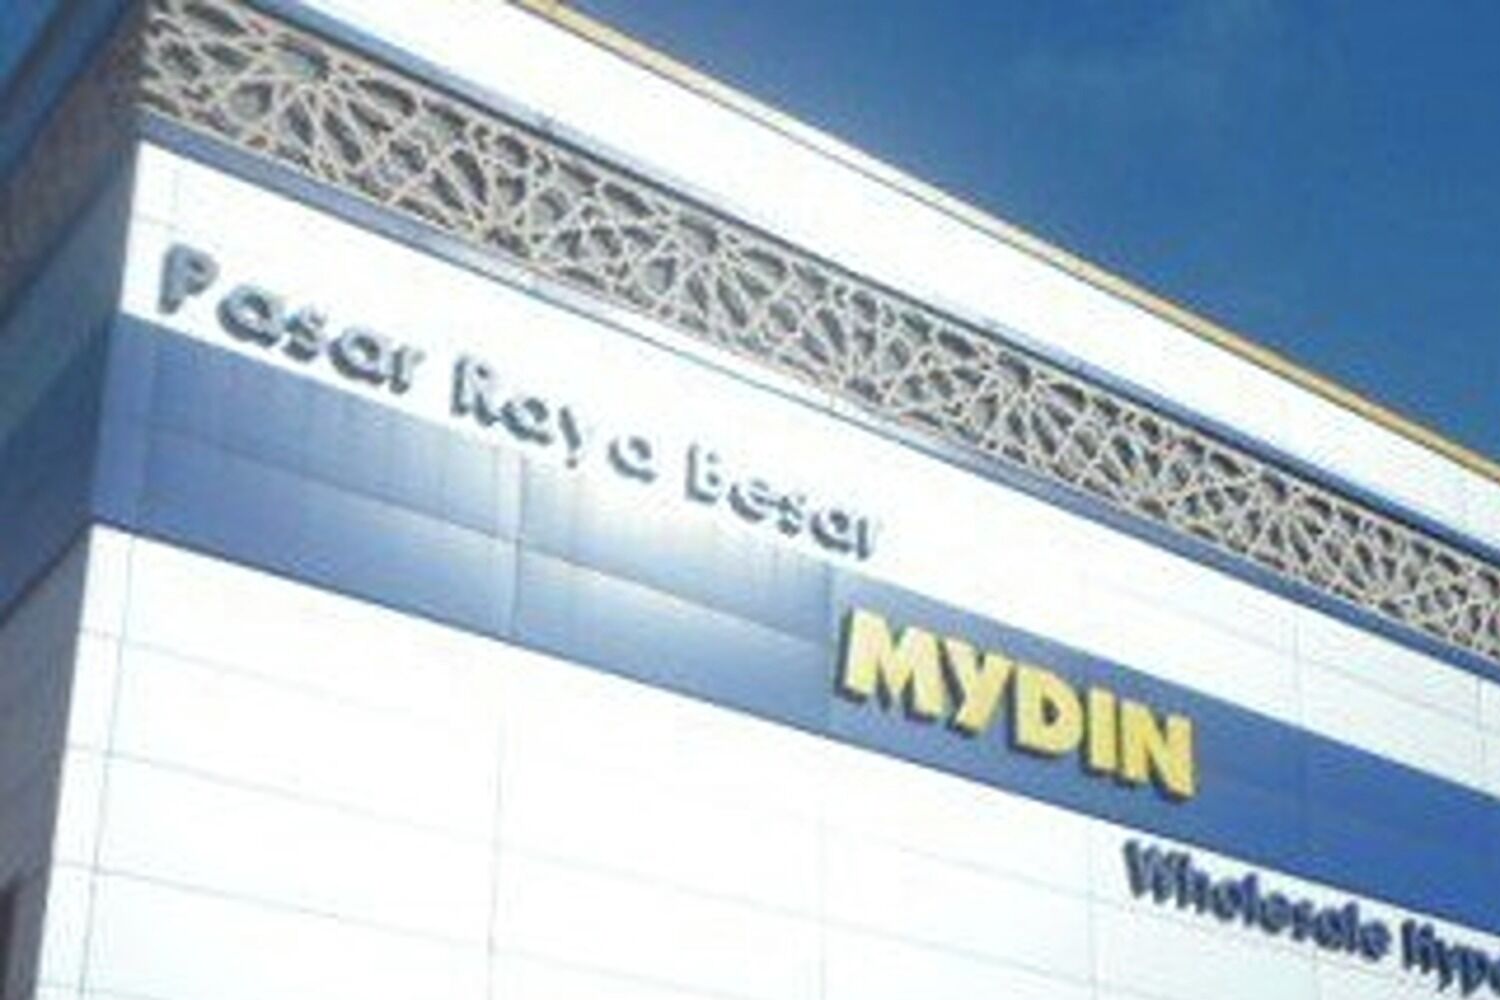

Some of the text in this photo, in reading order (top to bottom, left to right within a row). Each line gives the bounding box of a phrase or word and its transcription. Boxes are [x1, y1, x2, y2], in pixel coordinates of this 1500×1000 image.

[156, 242, 876, 560] Pasar Raya Besar
[838, 607, 1196, 799] MYDIN
[1122, 838, 1389, 965] Wholesale
